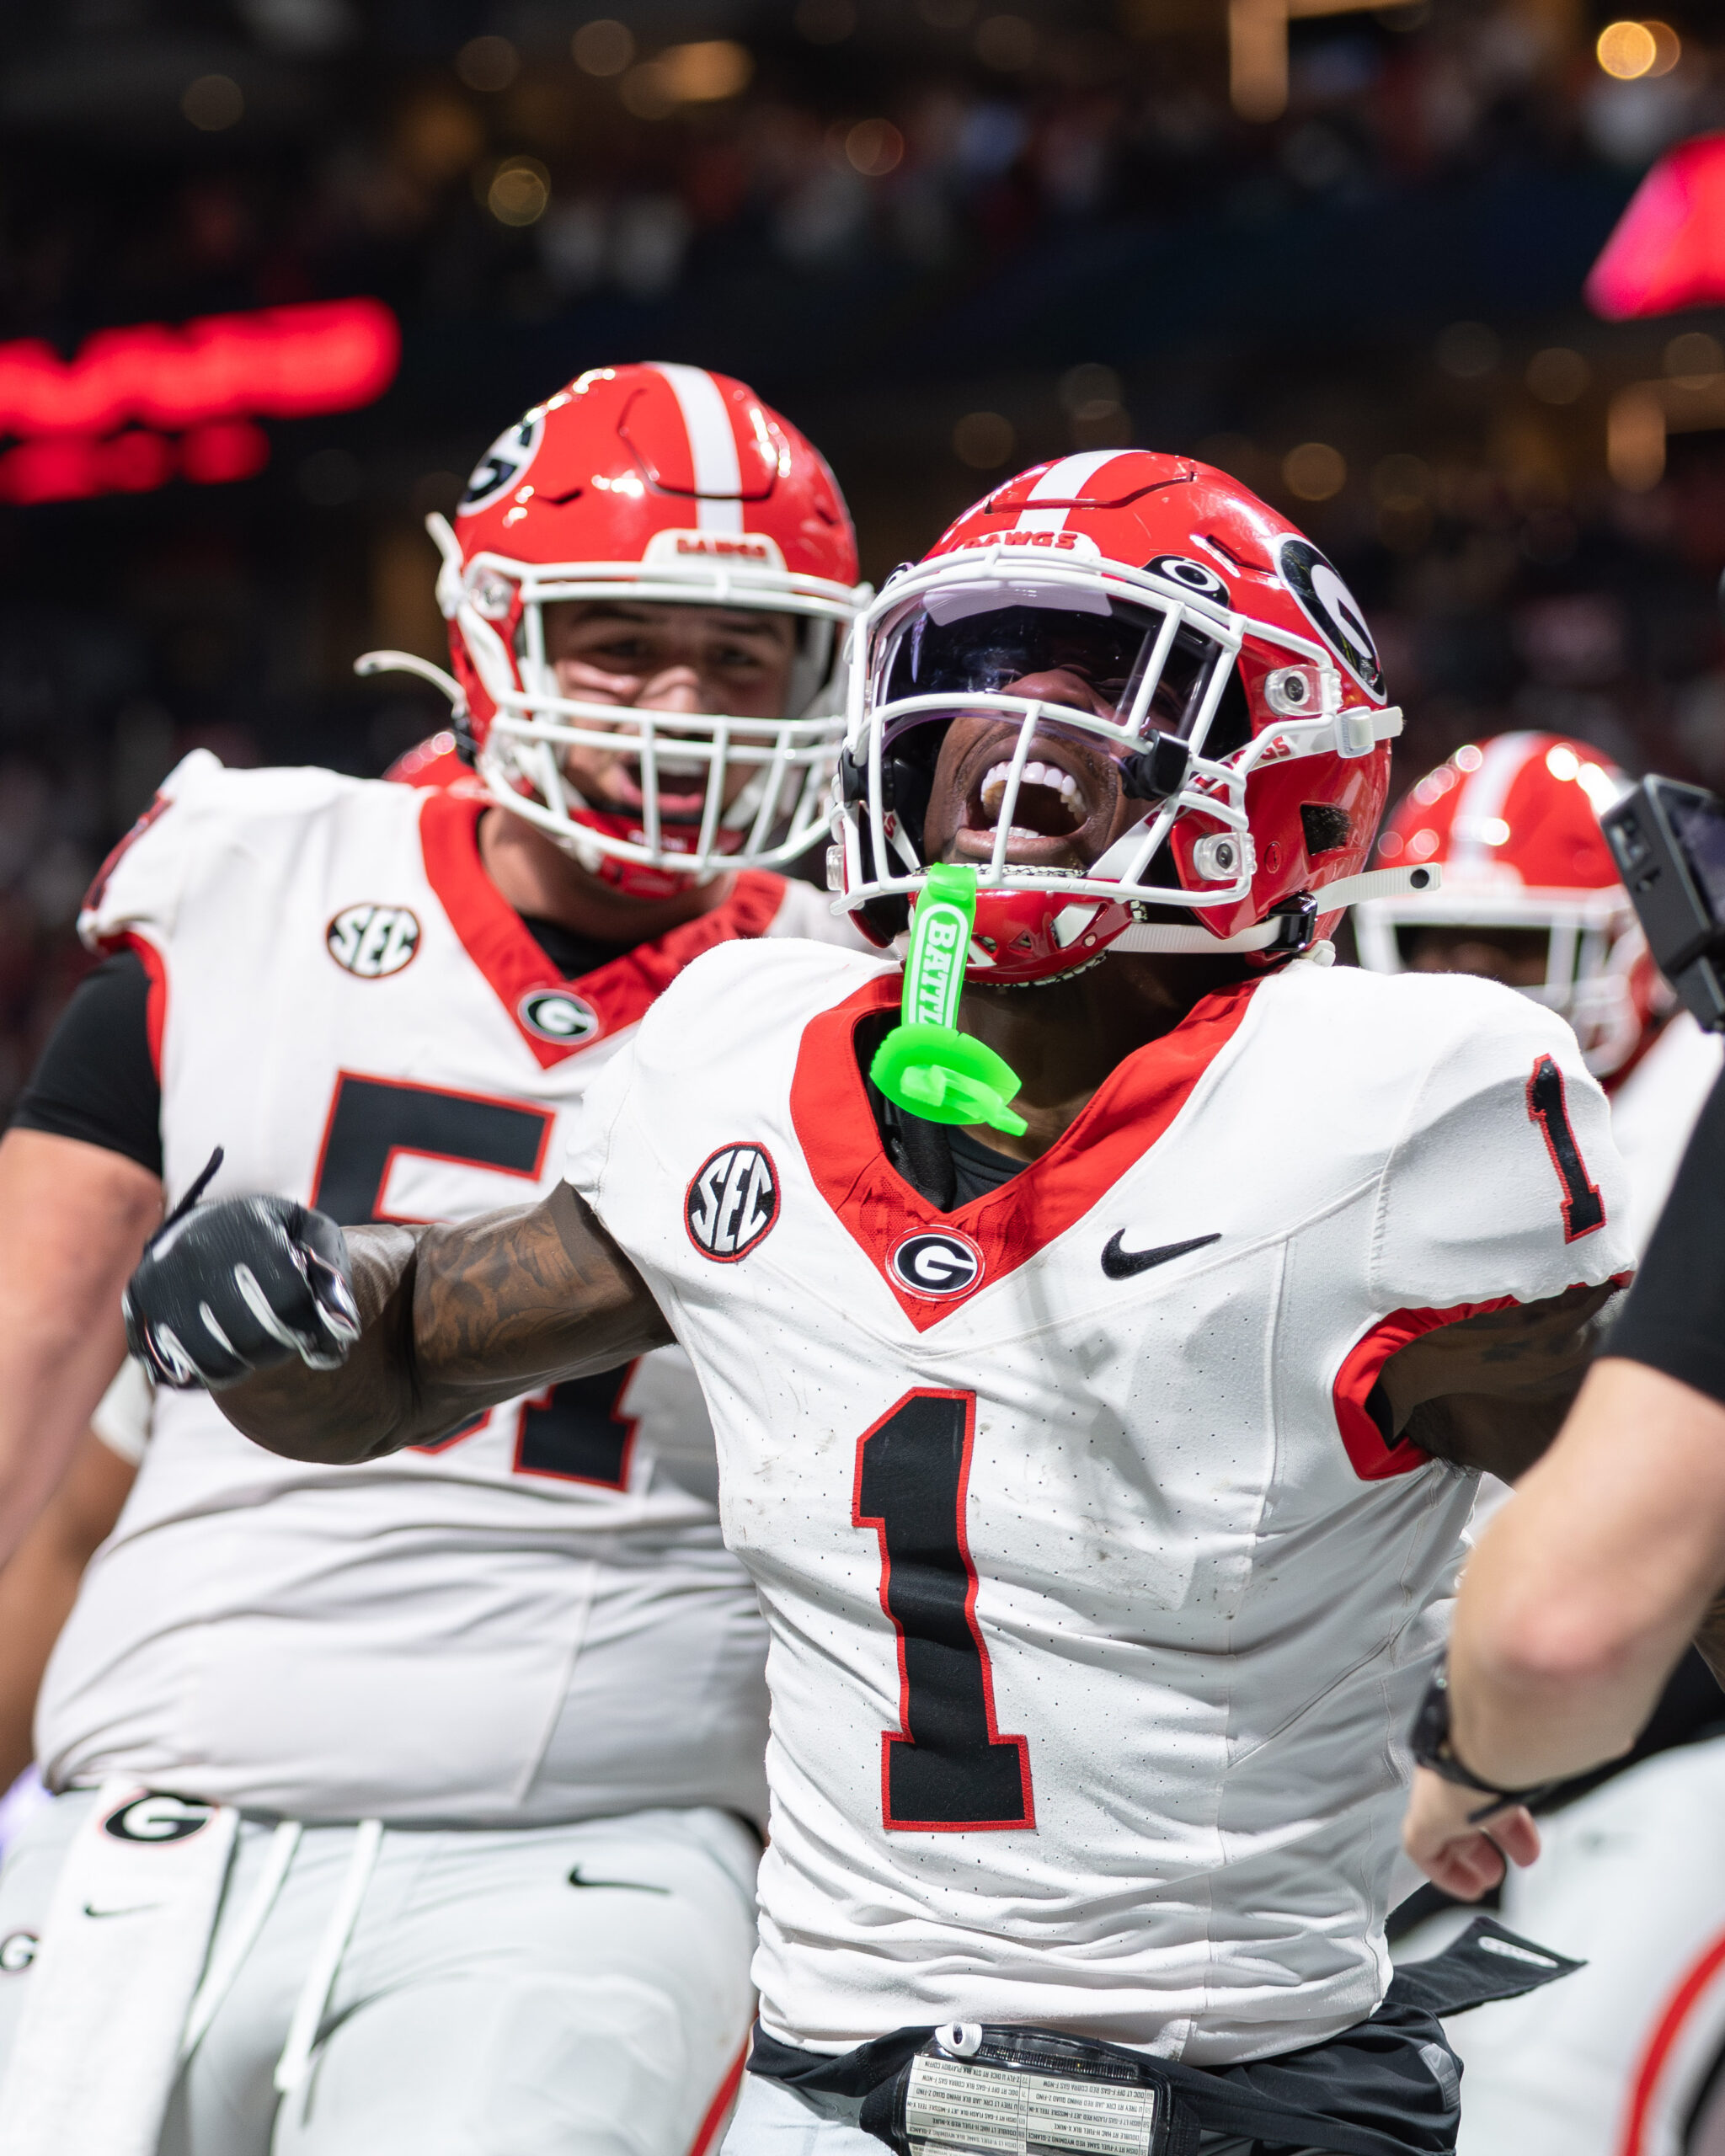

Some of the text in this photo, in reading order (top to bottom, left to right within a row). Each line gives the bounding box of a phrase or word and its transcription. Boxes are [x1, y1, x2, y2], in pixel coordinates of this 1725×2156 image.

[328, 906, 418, 975] SEC
[526, 997, 589, 1035] G
[1526, 1053, 1606, 1245] 1
[692, 1149, 772, 1252] SEC
[898, 1236, 975, 1290] G
[852, 1386, 1035, 1832] 1
[106, 1794, 208, 1841] G
[942, 2063, 962, 2073] PLAYBOY
[947, 2094, 961, 2102] RHINO
